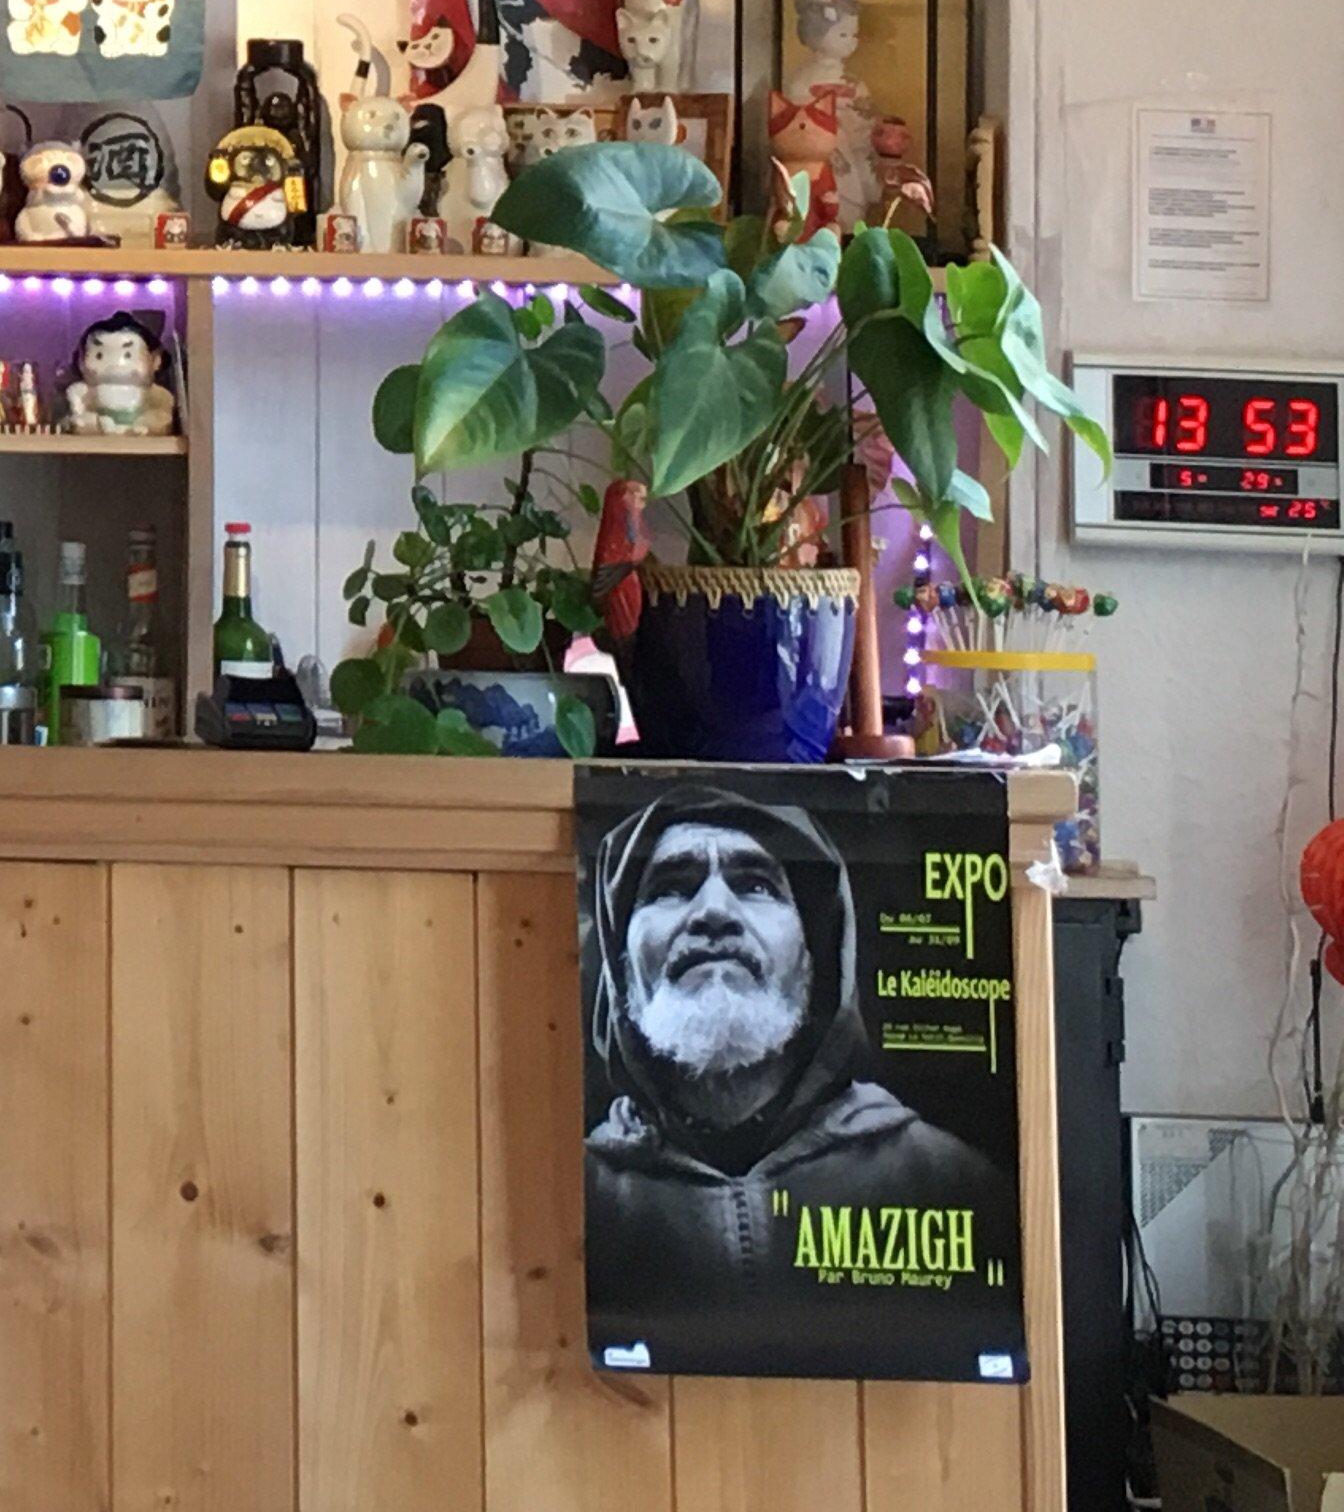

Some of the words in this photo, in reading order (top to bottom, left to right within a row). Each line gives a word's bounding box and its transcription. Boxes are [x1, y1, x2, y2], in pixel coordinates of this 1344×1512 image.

[1154, 395, 1209, 454] 13
[1244, 396, 1319, 455] 53
[924, 851, 1008, 903] EXPO
[877, 968, 897, 997] Le
[818, 1269, 845, 1285] Par
[852, 1269, 895, 1286] Bruno
